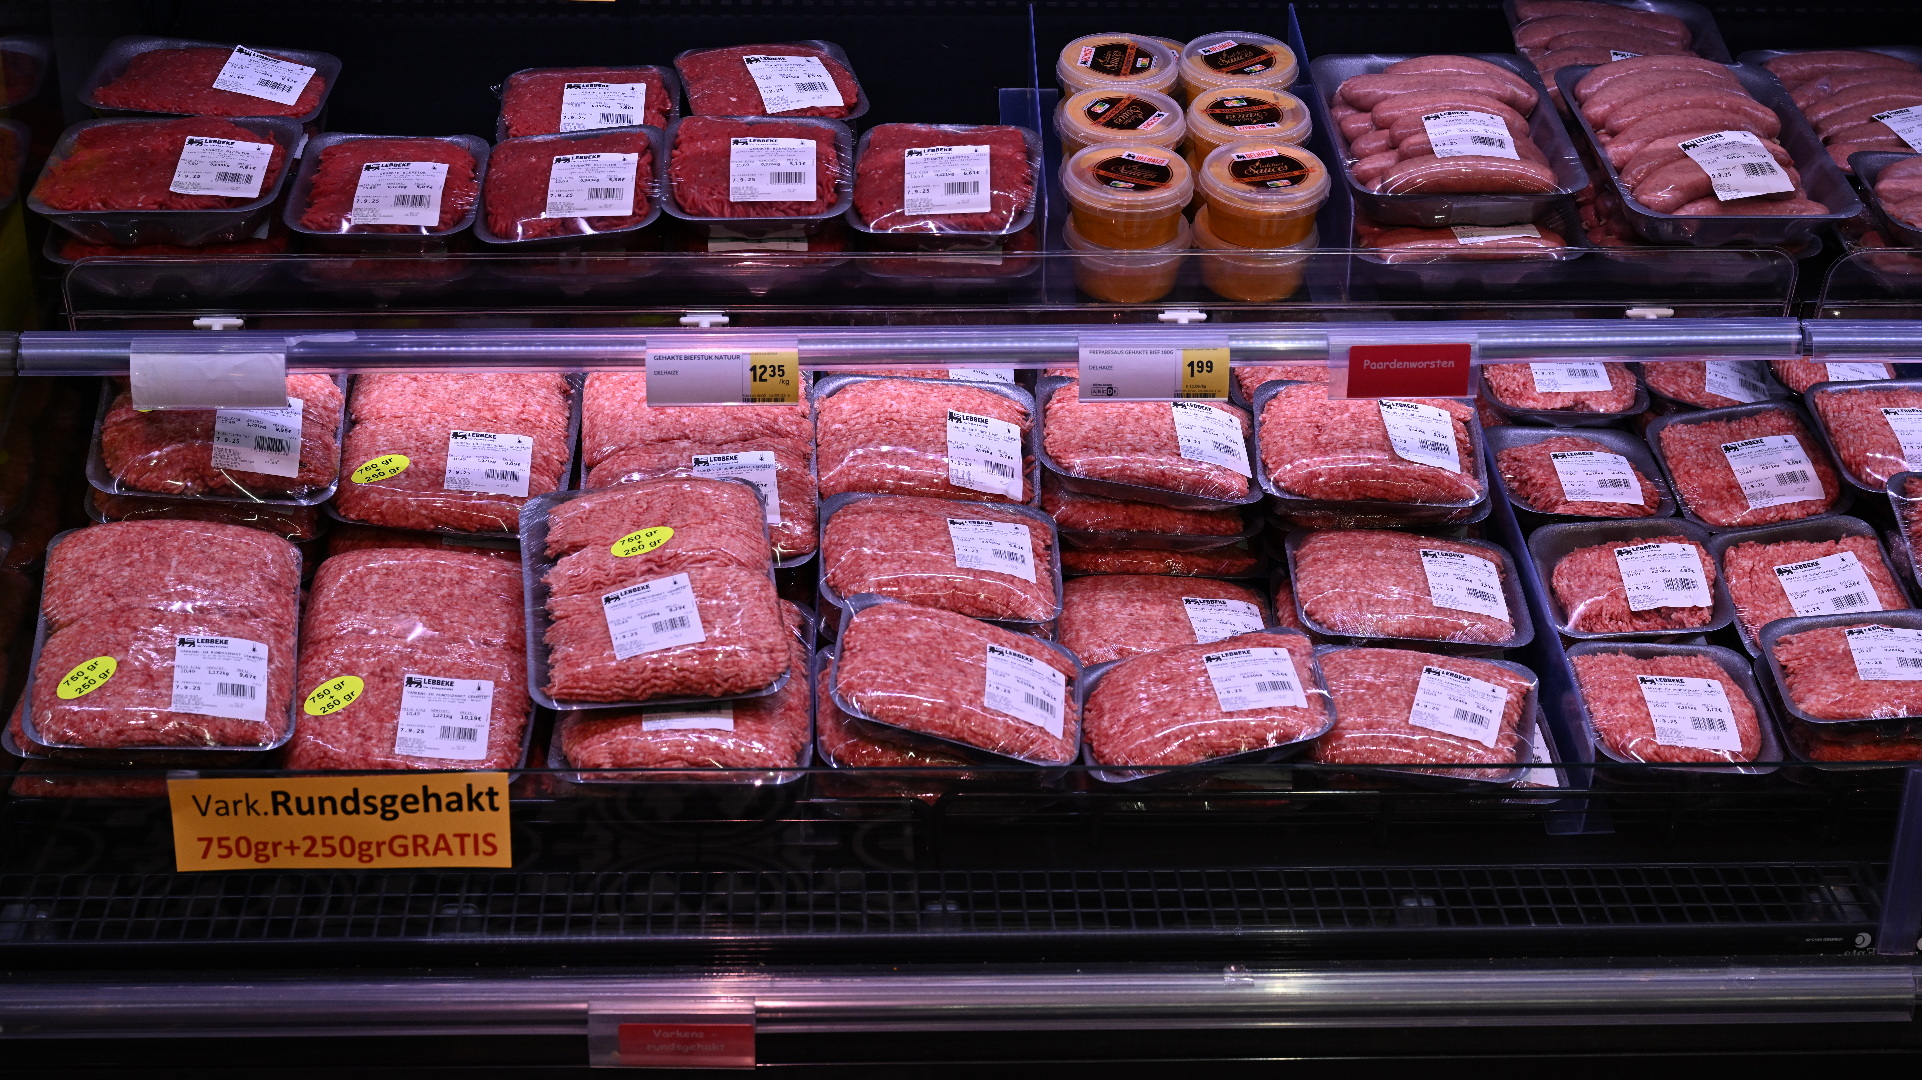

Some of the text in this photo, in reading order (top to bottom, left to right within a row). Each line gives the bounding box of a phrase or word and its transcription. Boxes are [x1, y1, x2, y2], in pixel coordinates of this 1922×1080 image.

[1136, 154, 1166, 165] DELHAIZE
[1246, 149, 1274, 159] DELHAIZE
[1244, 163, 1288, 176] Sauces
[1363, 358, 1455, 370] Paardenworsten
[778, 378, 790, 386] /kg
[962, 414, 989, 425] LEBBEKE
[1737, 438, 1765, 448] LEBBEKE
[357, 457, 393, 474] 750 gr
[365, 466, 400, 482] 250 gr
[620, 530, 658, 546] 750 gr
[624, 538, 662, 556] 250 gr
[1791, 561, 1820, 570] LEBBEKE
[620, 583, 651, 597] LEBBEKE
[614, 631, 638, 641] 7.9.25
[1005, 649, 1034, 663] LEBBEKE
[1221, 649, 1251, 658] LEBBEKE
[63, 660, 99, 687] 750 gr
[1441, 671, 1471, 682] LEBBEKE
[75, 668, 111, 695] 250 gr
[423, 678, 455, 687] LEBBEKE
[309, 680, 346, 704] 750 gr
[988, 683, 1011, 694] 7.9.25
[320, 690, 356, 714] 250 gr
[196, 833, 498, 863] 750gr+250grGRATIS
[653, 1029, 704, 1038] Varkens
[646, 1042, 724, 1053] rundsgehakt
